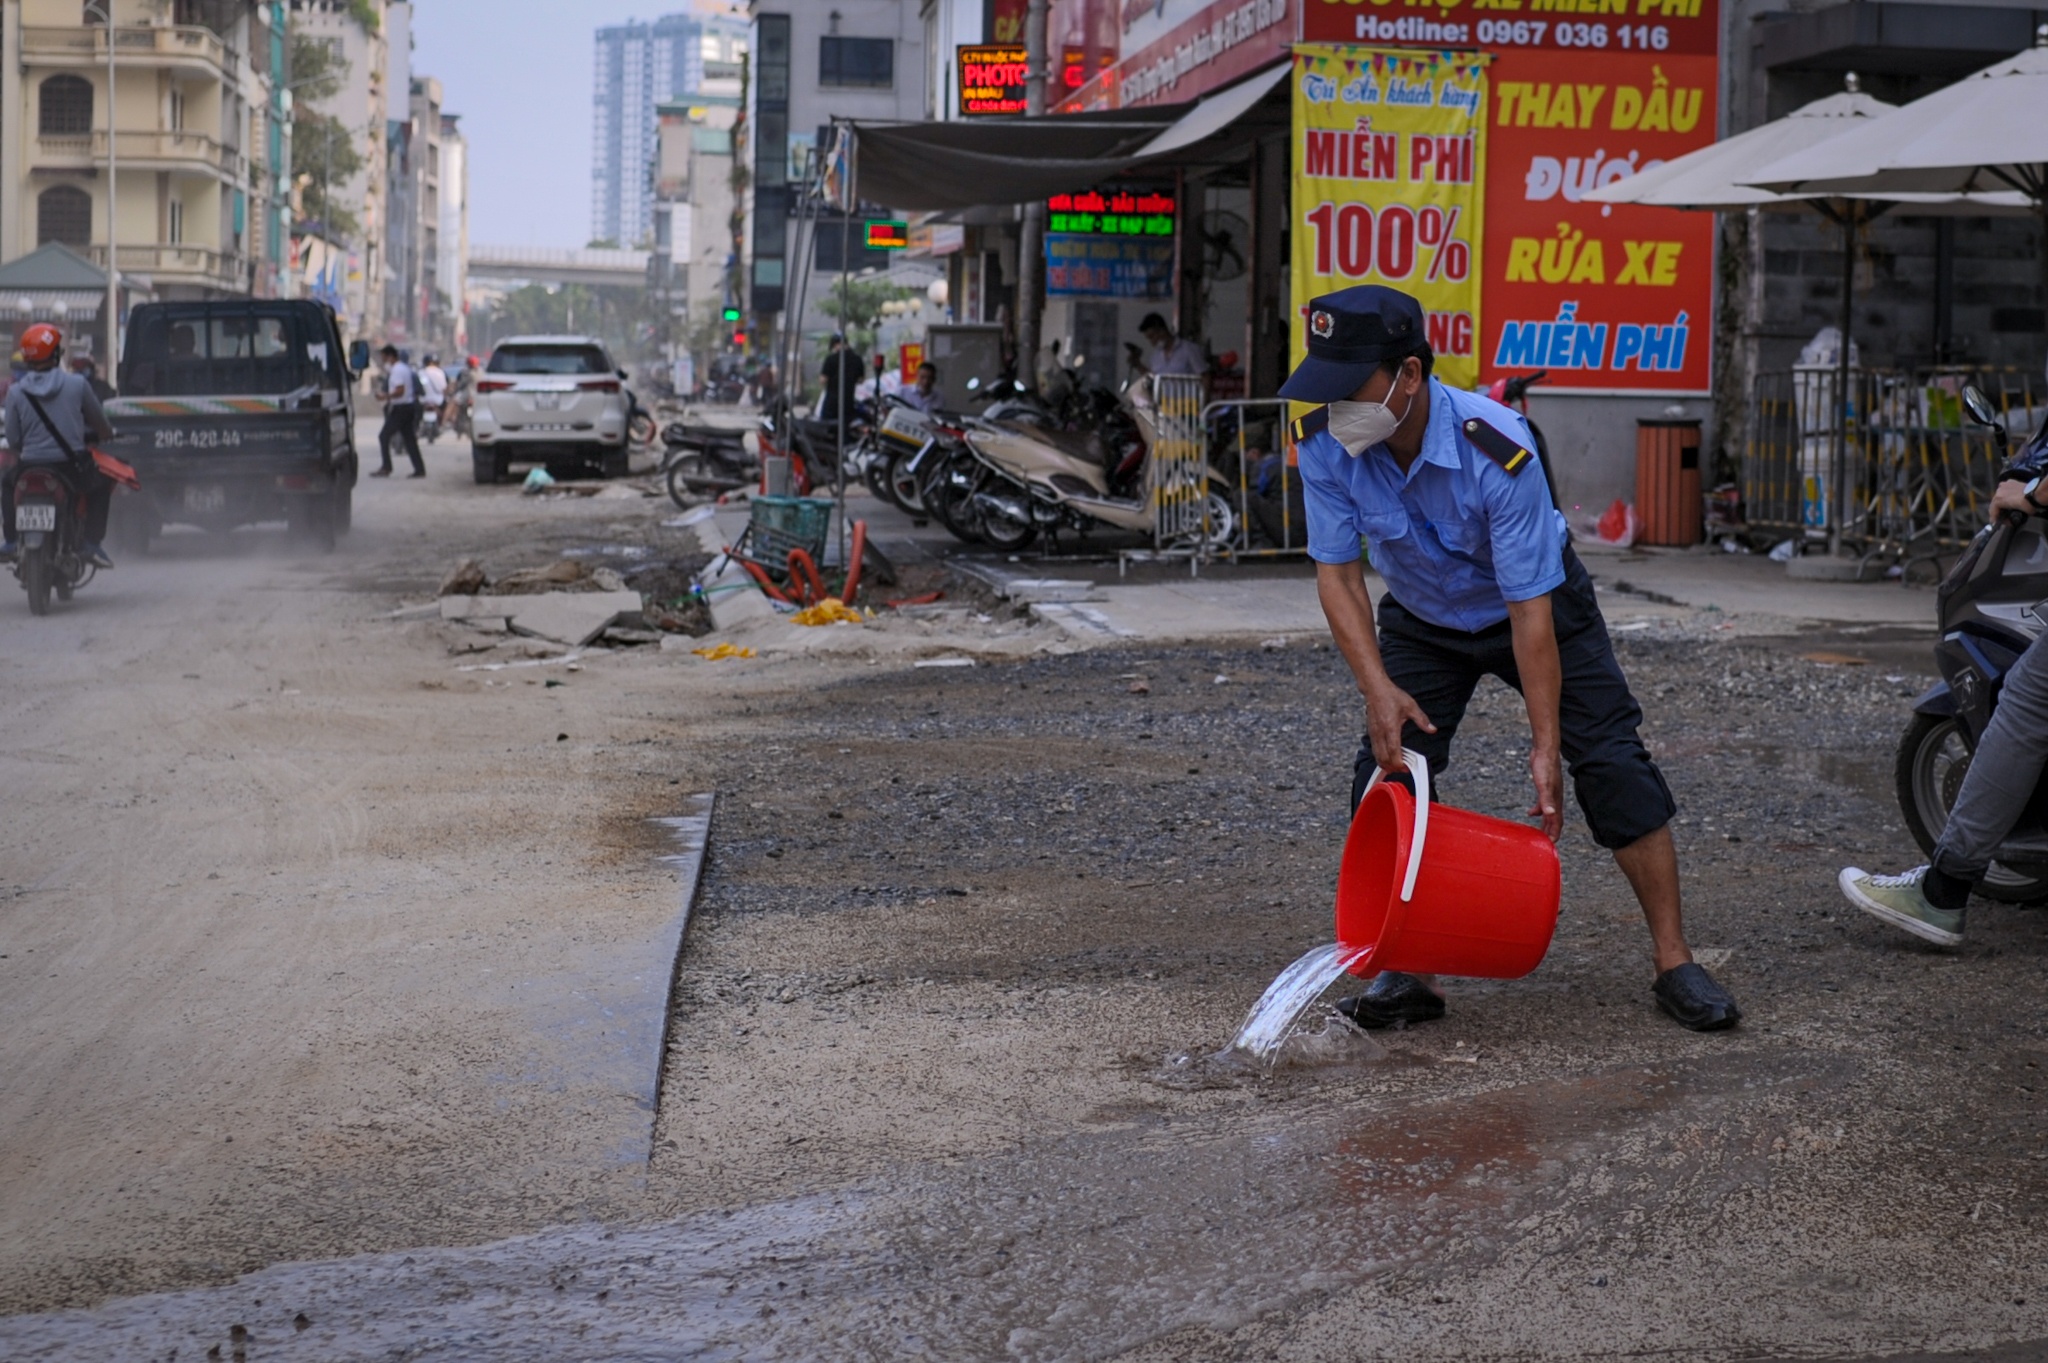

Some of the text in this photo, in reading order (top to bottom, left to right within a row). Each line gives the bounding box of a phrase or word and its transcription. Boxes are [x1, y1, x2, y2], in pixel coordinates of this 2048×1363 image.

[1356, 15, 1669, 50] Hotline: 0967 036 116
[1303, 74, 1336, 103] Tri
[1385, 79, 1433, 106] khách
[1440, 82, 1480, 117] hàng
[1498, 65, 1703, 132] THAY DẦU
[1305, 116, 1476, 183] MIỄN PHÍ
[1525, 149, 1668, 217] ĐƯỢ
[1305, 202, 1470, 282] 100%
[1505, 222, 1683, 286] RỬA XE
[1493, 300, 1689, 371] MIỄN PHÍ
